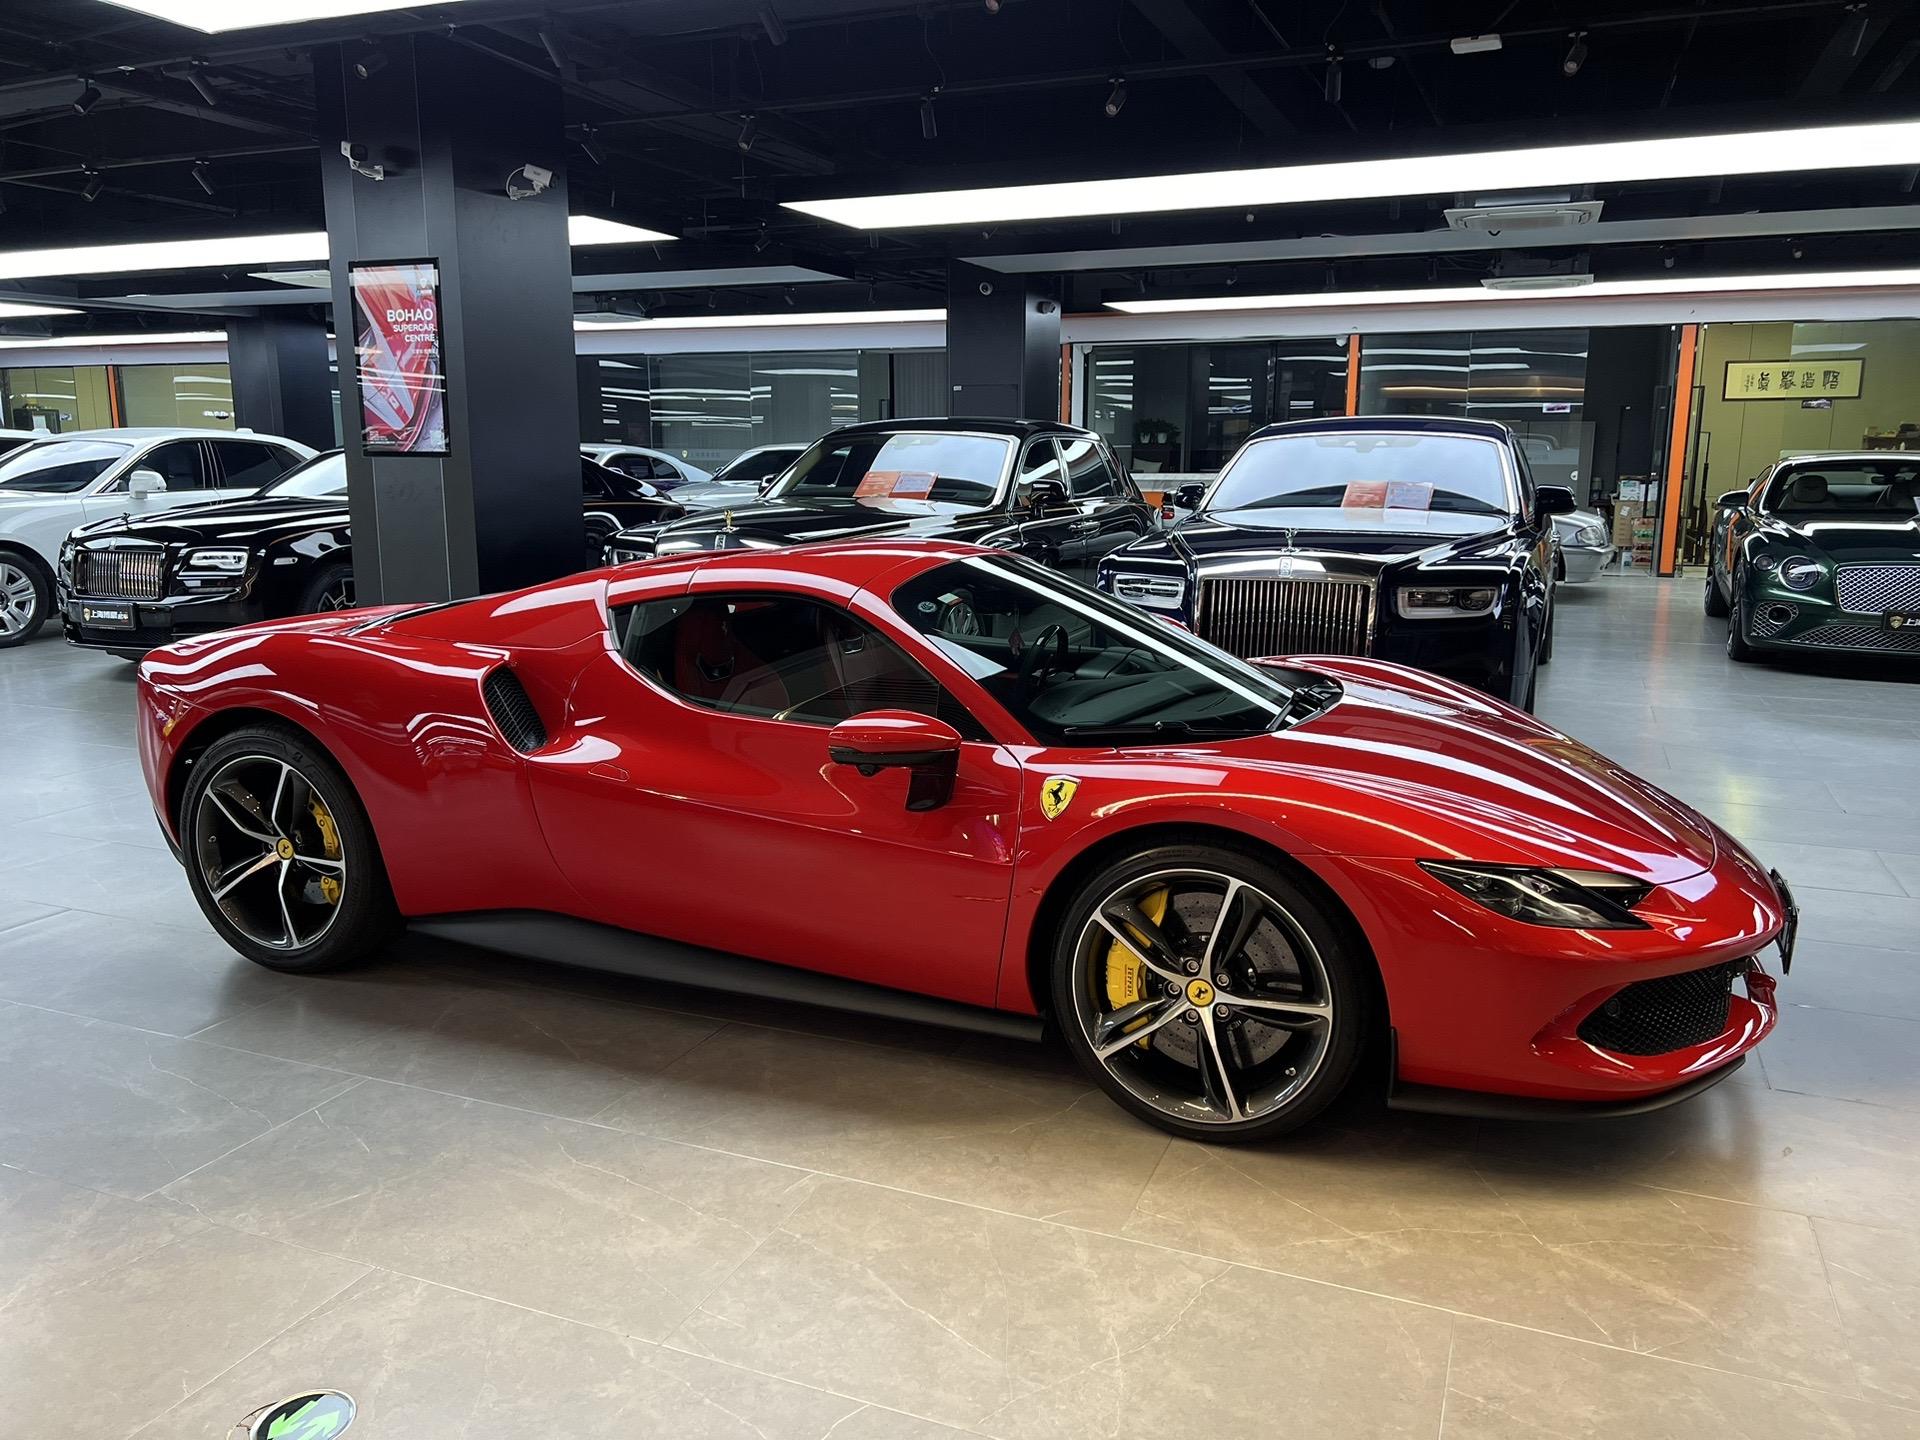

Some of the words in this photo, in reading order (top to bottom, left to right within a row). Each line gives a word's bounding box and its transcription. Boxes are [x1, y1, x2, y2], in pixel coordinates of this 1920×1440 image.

[386, 308, 433, 322] BOHAO
[393, 323, 435, 332] SUPERCAR
[404, 333, 435, 342] CENTRE
